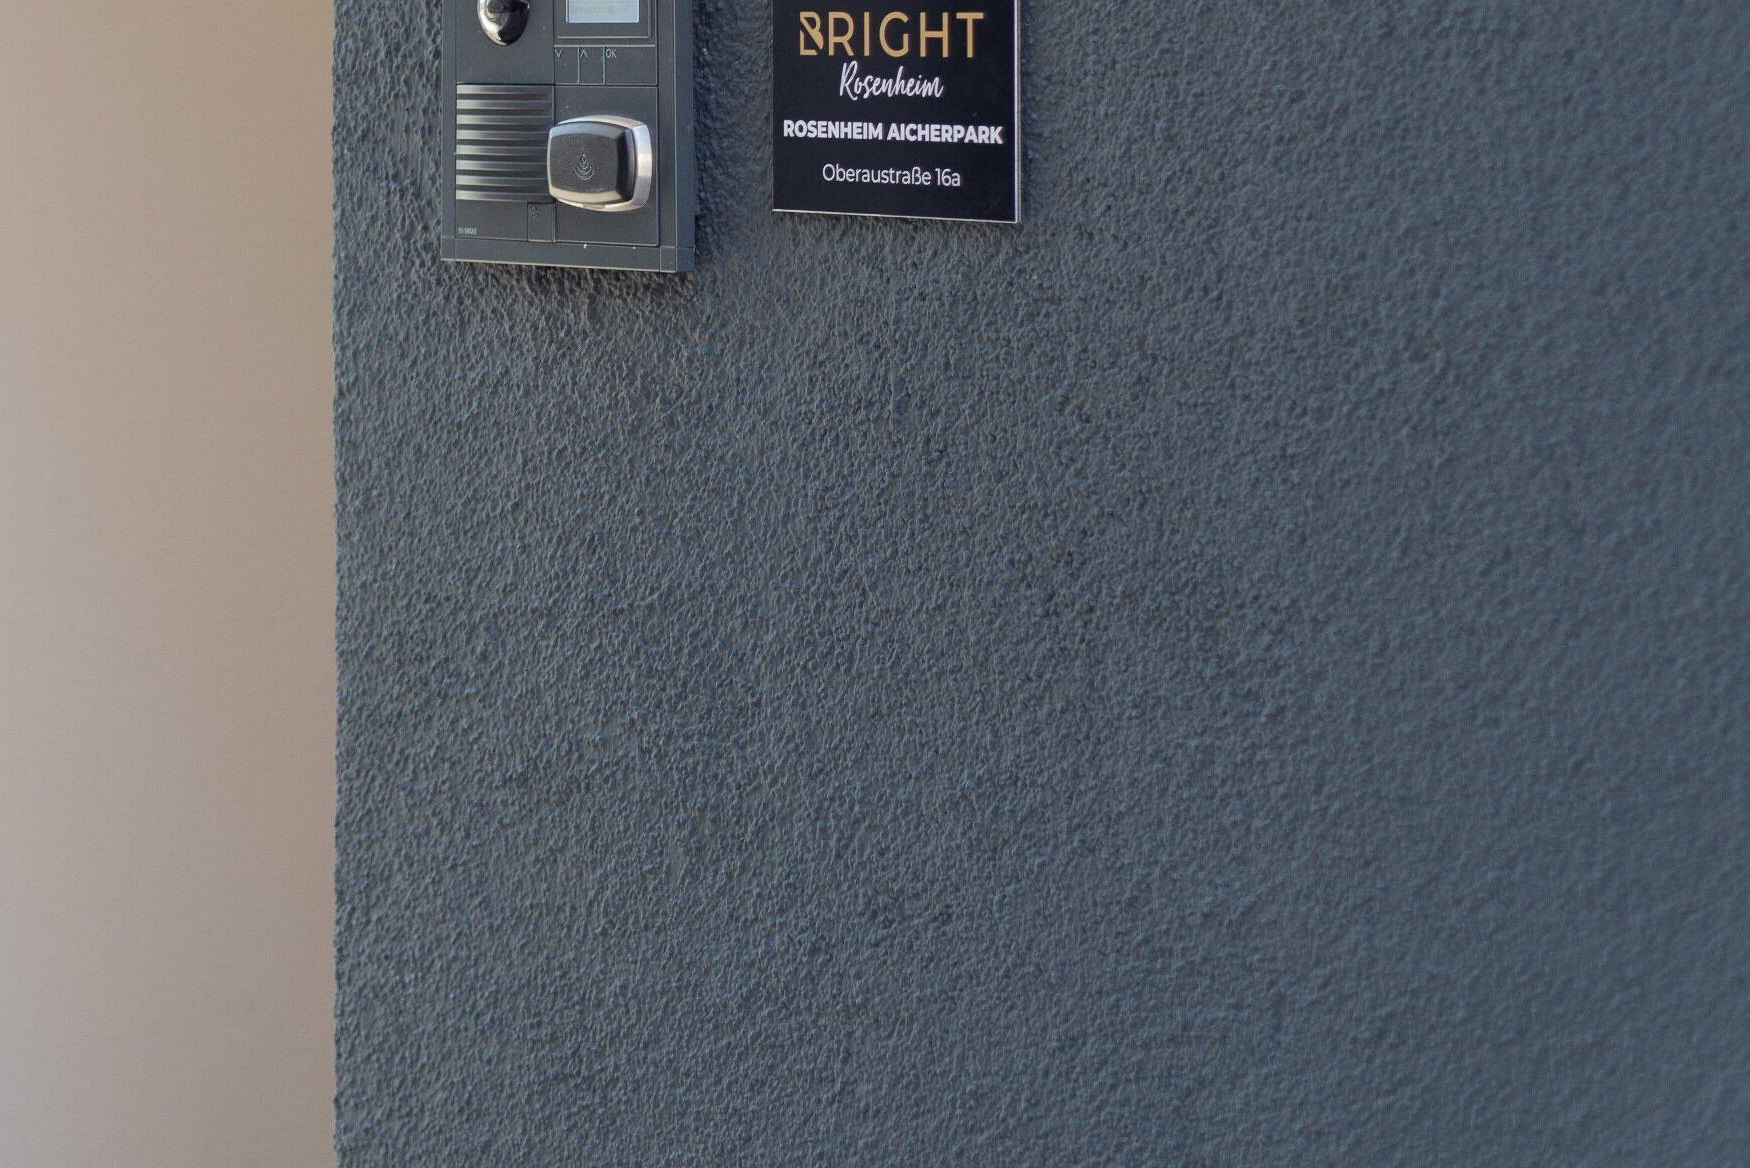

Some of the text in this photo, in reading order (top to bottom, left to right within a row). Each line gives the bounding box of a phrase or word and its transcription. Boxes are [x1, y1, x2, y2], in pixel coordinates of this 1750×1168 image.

[799, 11, 985, 58] BRIGHT
[605, 48, 617, 58] OK
[839, 60, 944, 101] Rosenheim
[783, 119, 1004, 144] ROSENHEIM AICHERPARK
[822, 163, 961, 186] Oberaustraße 16a
